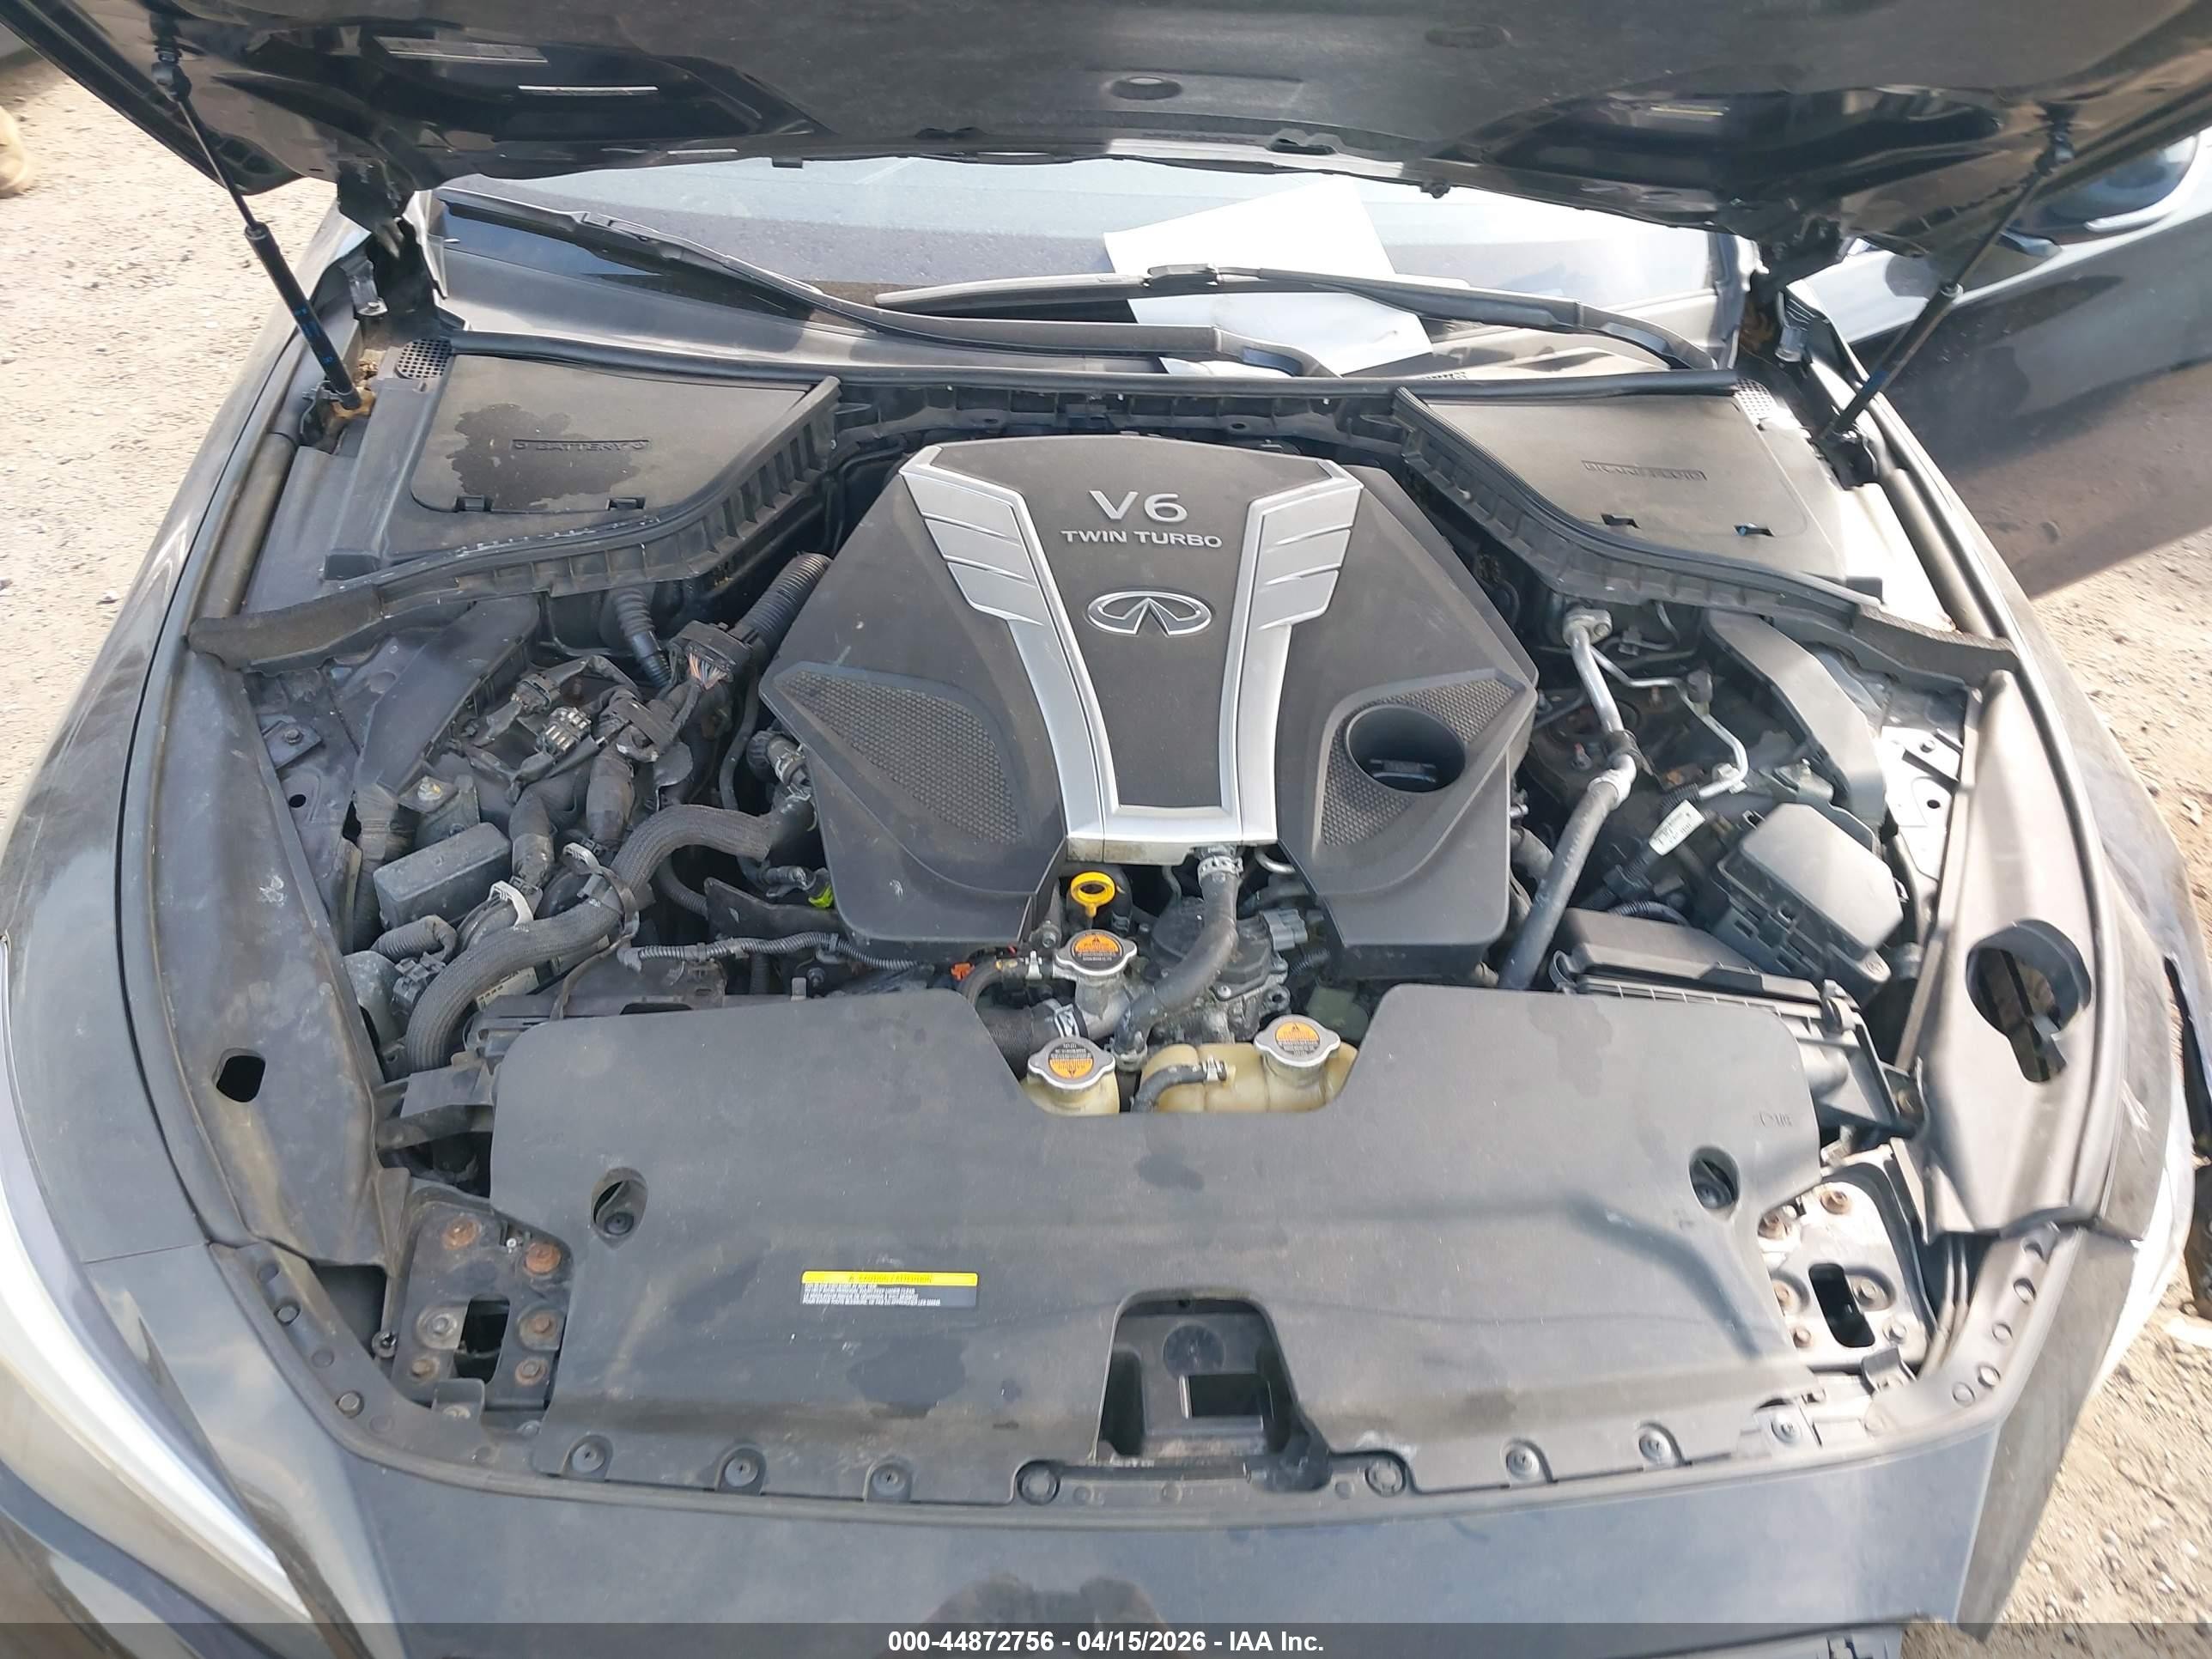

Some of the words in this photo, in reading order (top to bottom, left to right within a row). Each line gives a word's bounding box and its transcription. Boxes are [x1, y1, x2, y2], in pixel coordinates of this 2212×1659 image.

[1089, 489, 1188, 523] V6
[1060, 530, 1127, 544] TWIN
[1133, 531, 1224, 549] TURBO
